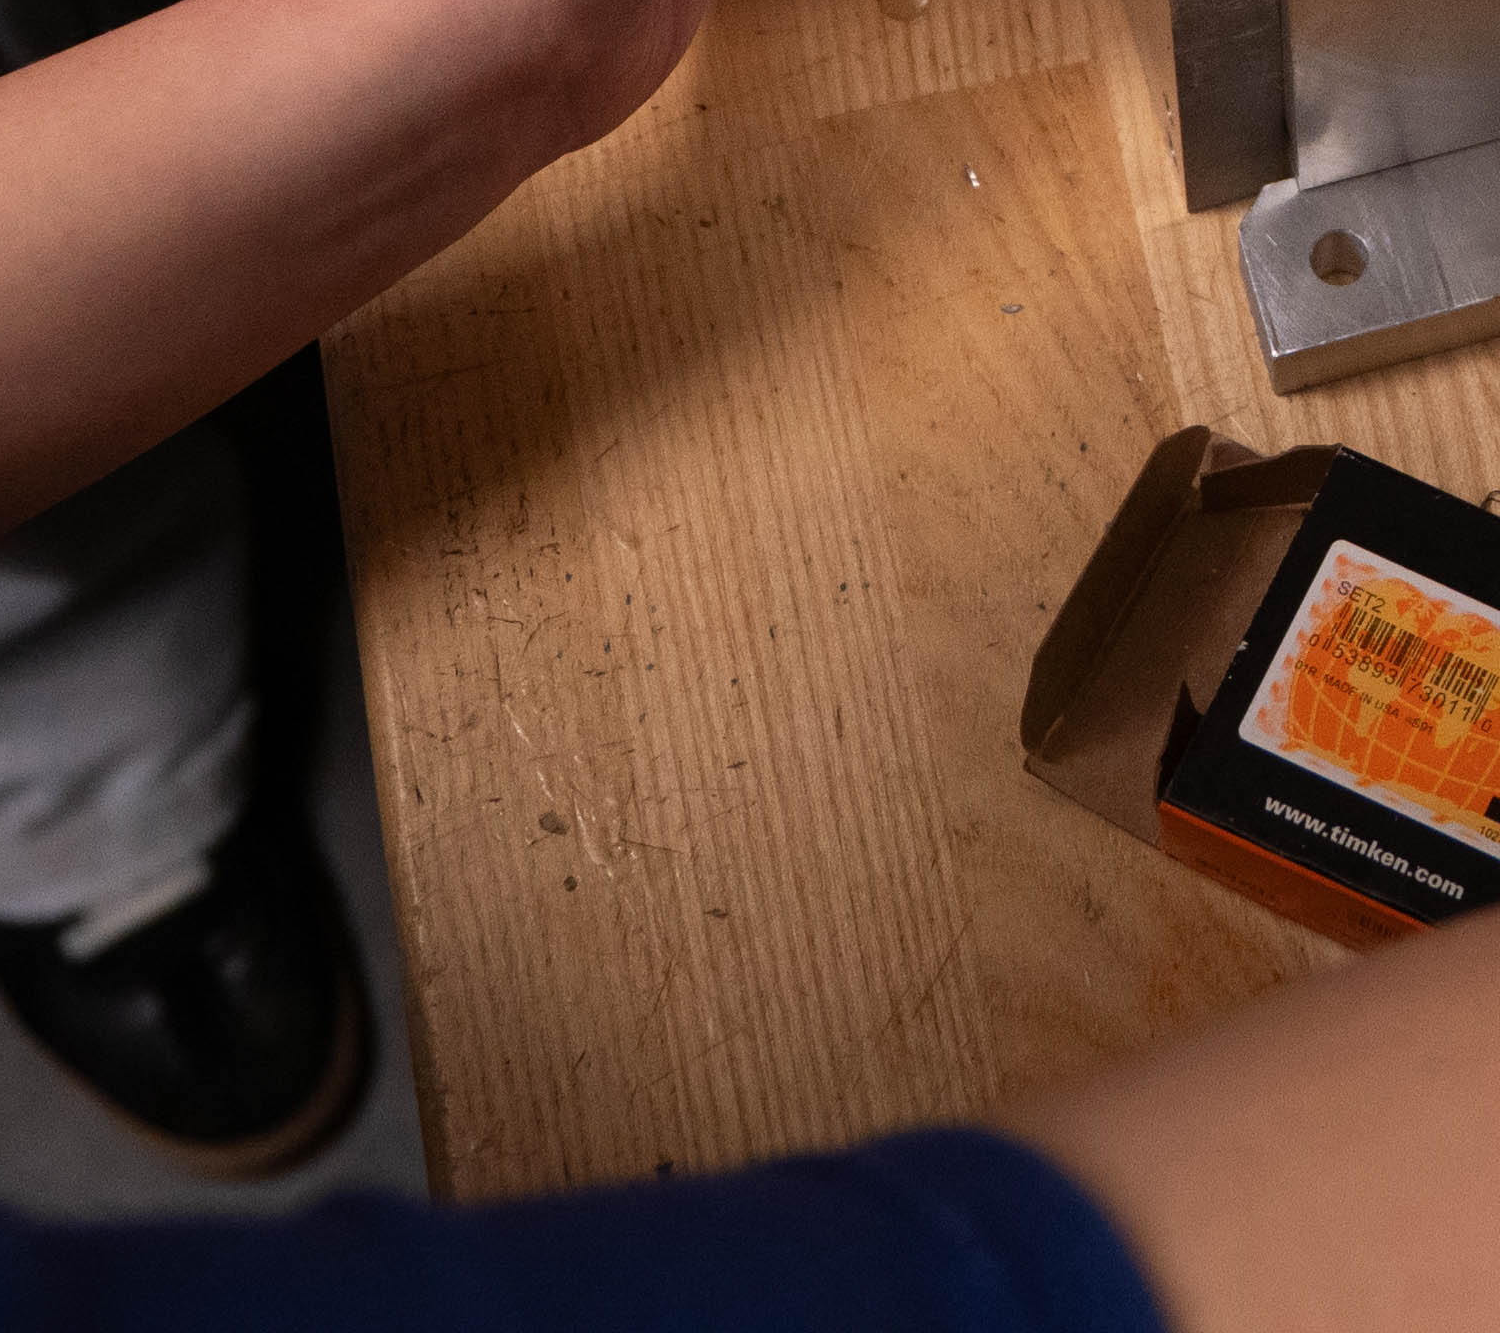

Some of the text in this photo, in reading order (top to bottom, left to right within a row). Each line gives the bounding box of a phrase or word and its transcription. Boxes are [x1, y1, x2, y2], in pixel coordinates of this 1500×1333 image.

[1334, 578, 1388, 615] SET2
[1321, 672, 1358, 698] MADE
[1357, 690, 1374, 705] IN
[1372, 697, 1401, 719] USA
[1329, 641, 1399, 686] 53893
[1404, 677, 1474, 723] 73011
[1264, 796, 1466, 901] www.timken.com
